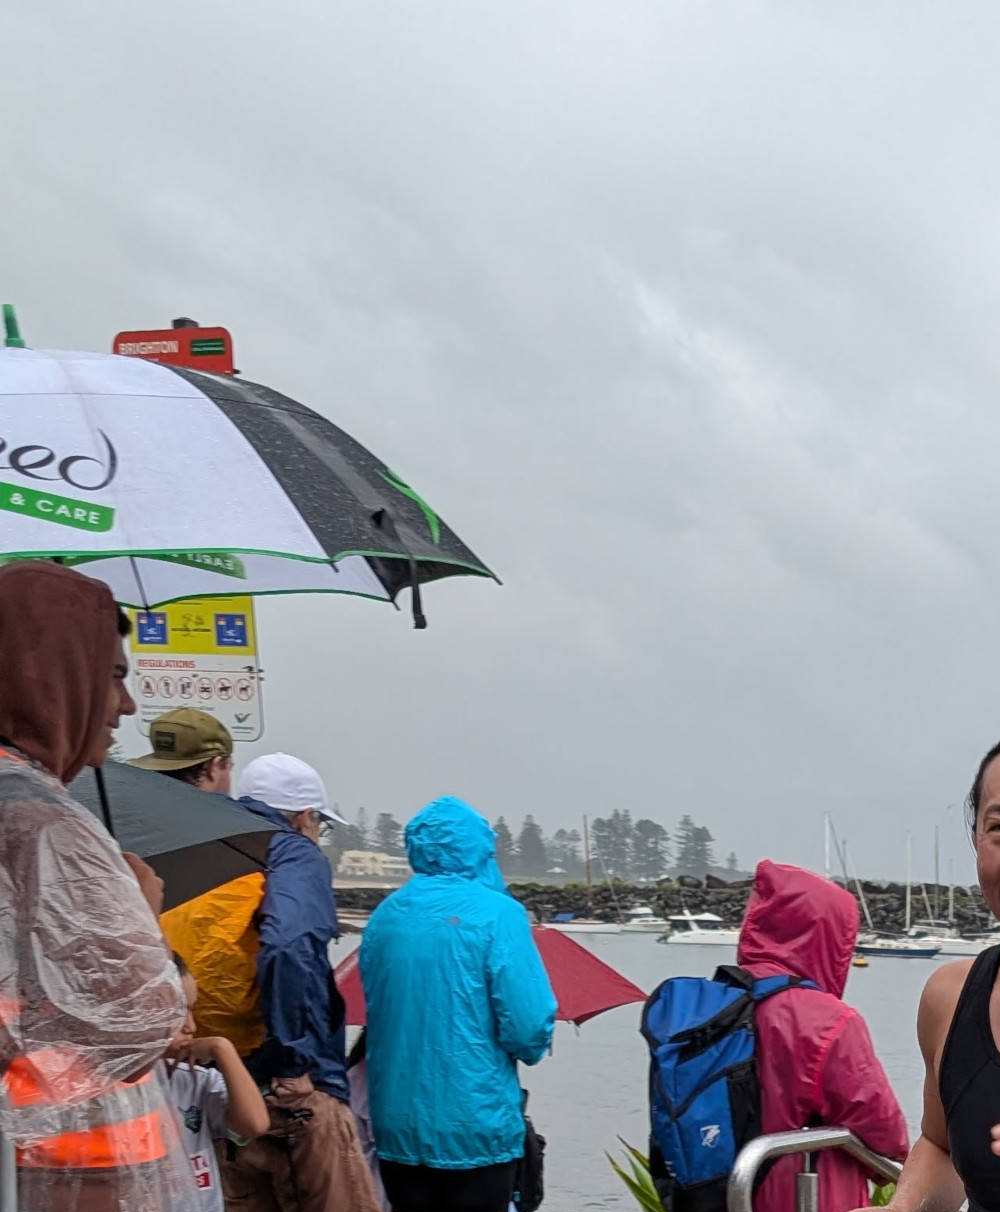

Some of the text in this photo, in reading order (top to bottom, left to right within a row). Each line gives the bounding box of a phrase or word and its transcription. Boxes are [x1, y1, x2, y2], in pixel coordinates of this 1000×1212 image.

[9, 492, 101, 525] & CARE
[137, 658, 196, 669] REGULATIONS
